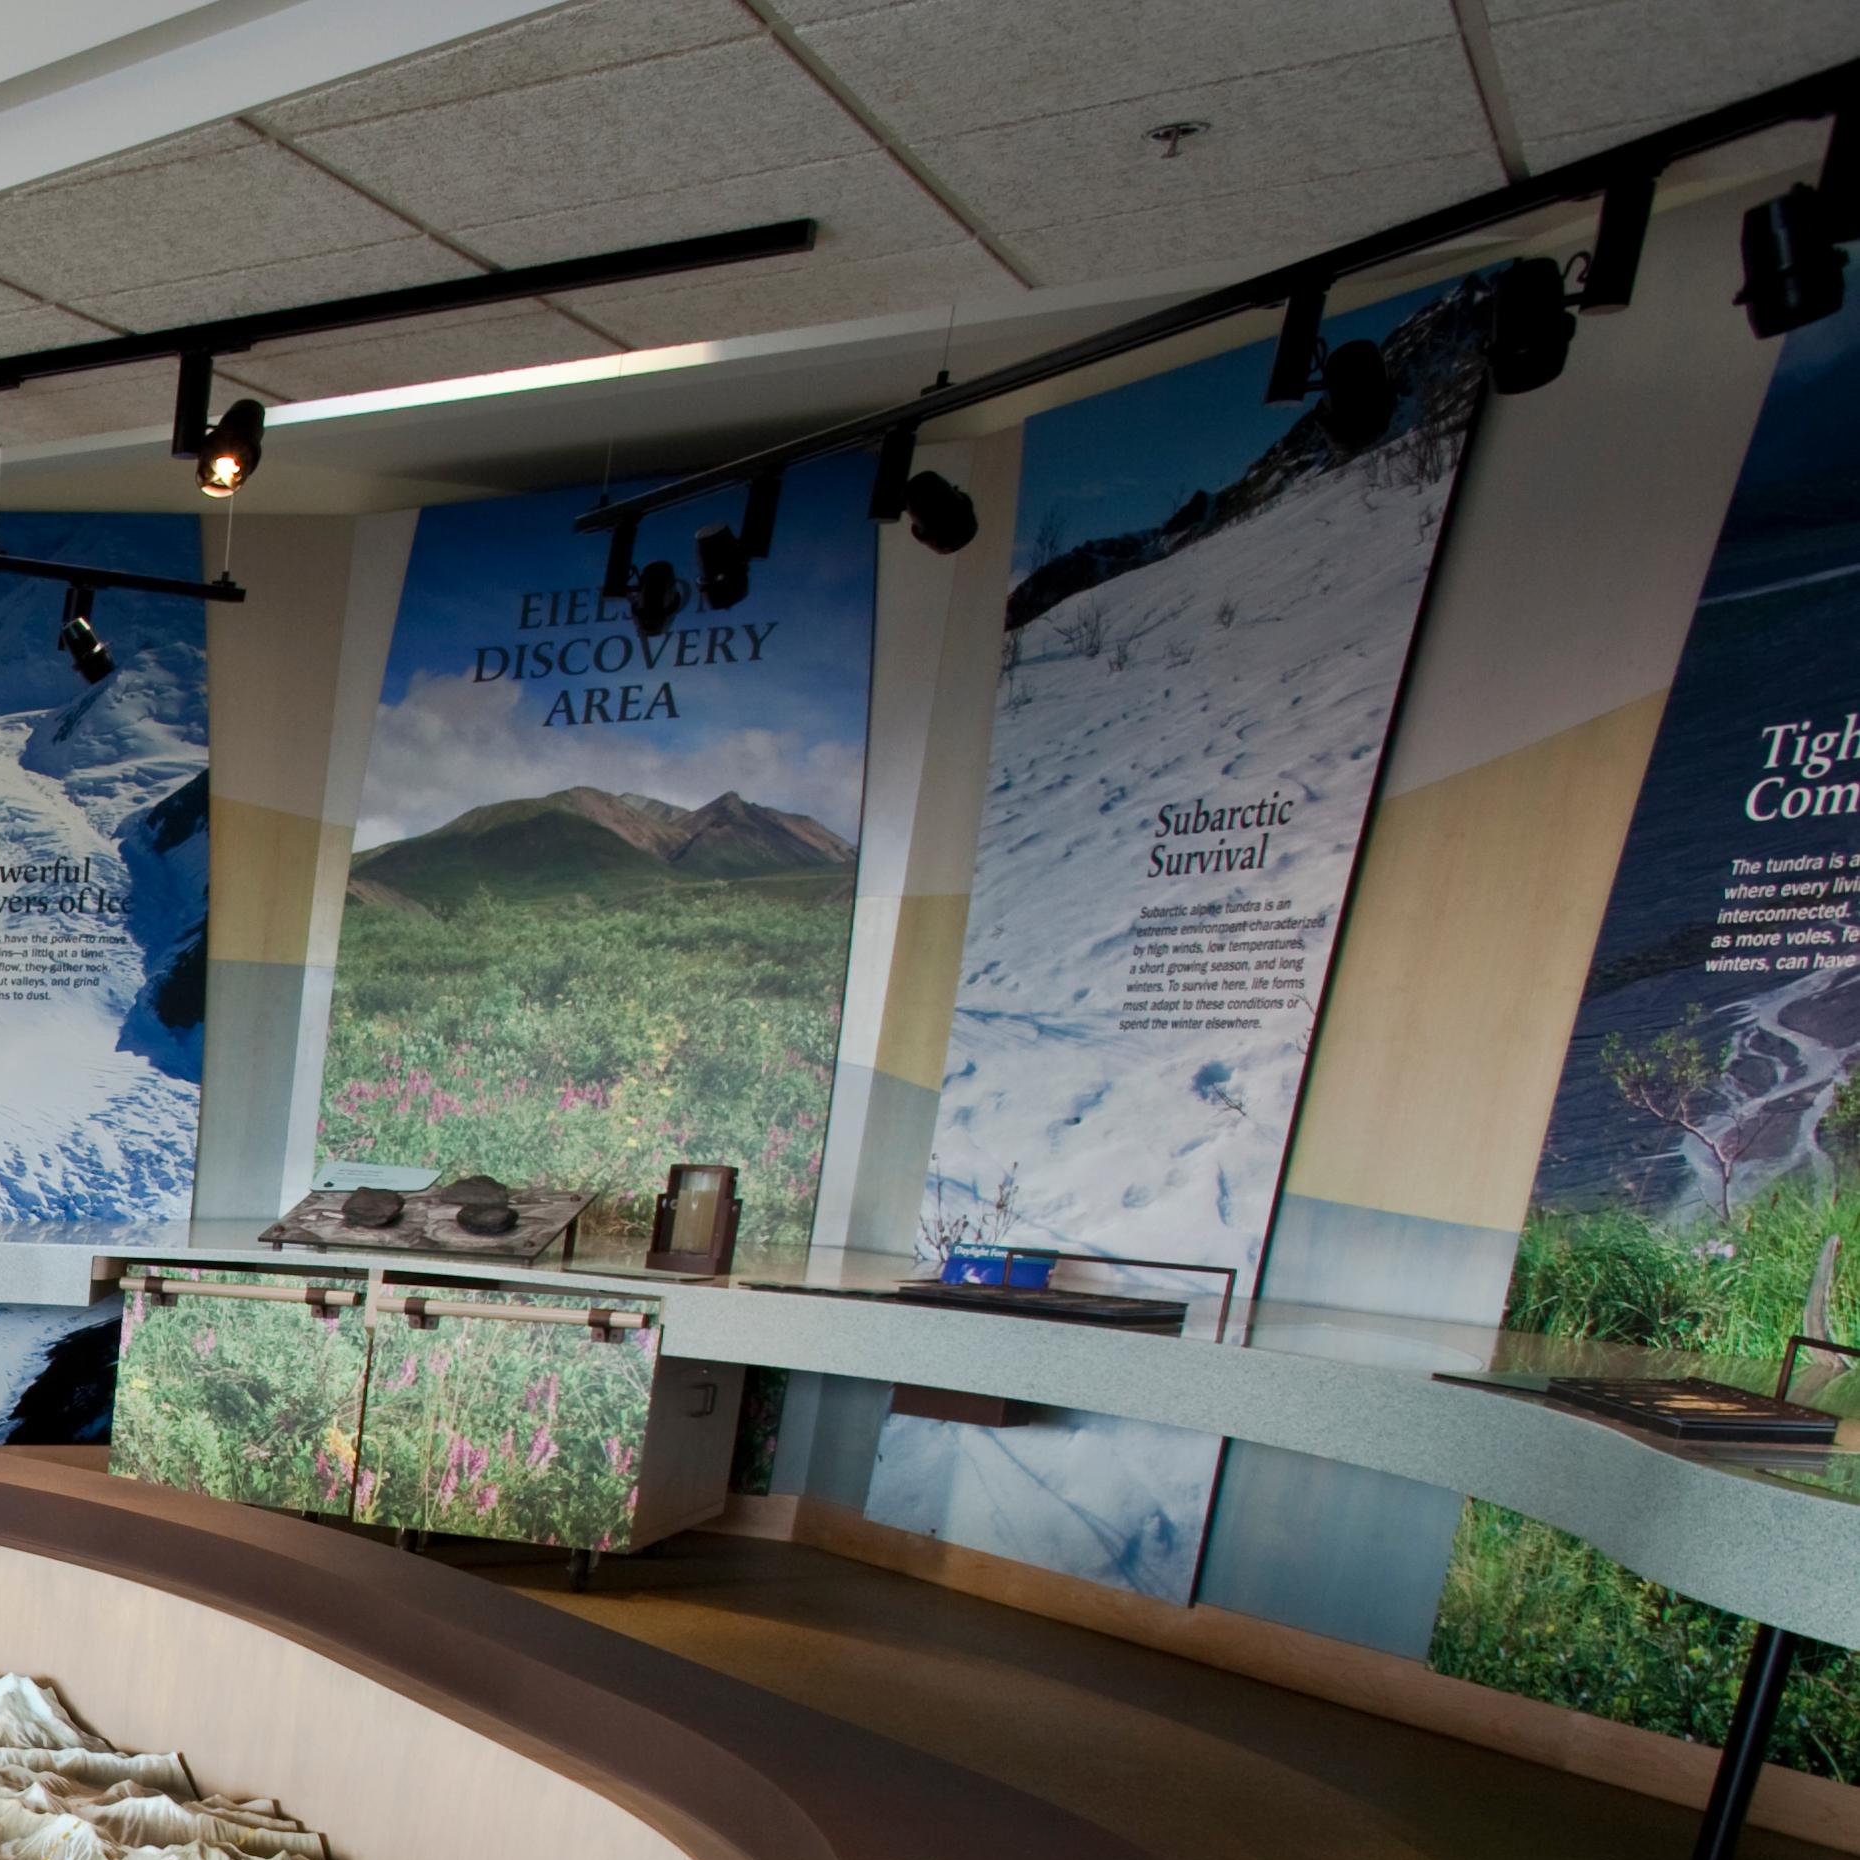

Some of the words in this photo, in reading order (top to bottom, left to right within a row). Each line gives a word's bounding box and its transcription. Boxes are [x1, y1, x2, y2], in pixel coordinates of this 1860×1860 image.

[473, 622, 779, 682] DISCOVERY
[543, 682, 680, 727] AREA
[1155, 791, 1294, 837] Subarctic
[1148, 834, 1270, 878] Survival
[1731, 859, 1761, 875] The
[1766, 855, 1823, 873] tundra
[1829, 852, 1844, 869] is
[59, 887, 93, 913] of
[98, 890, 134, 913] Ice
[1724, 884, 1776, 899] where
[1781, 881, 1829, 898] every
[1140, 905, 1188, 919] Subarctic
[1190, 904, 1222, 918] alpine
[1225, 902, 1261, 914] tundra
[1264, 900, 1273, 912] is
[1277, 899, 1291, 911] an
[1717, 902, 1851, 924] interconnected.
[1137, 925, 1178, 937] extreme
[1181, 921, 1247, 935] environment
[1249, 916, 1325, 932] characterized
[5, 934, 28, 943] have
[32, 934, 48, 943] the
[51, 935, 83, 946] power
[85, 935, 95, 944] to
[99, 935, 127, 944] move
[1133, 945, 1145, 957] by
[1148, 943, 1169, 957] high
[1172, 942, 1204, 955] winds,
[1207, 941, 1225, 953] low
[1229, 938, 1306, 953] temperatures,
[1711, 935, 1732, 948] as
[1735, 932, 1781, 946] more
[1786, 928, 1835, 945] voles,
[32, 948, 54, 958] little
[57, 949, 68, 957] at
[1705, 956, 1769, 972] winters,
[1776, 956, 1807, 970] can
[1813, 952, 1856, 968] have
[0, 962, 22, 973] flow,
[25, 962, 46, 975] they
[50, 963, 83, 974] gather
[11, 976, 48, 988] valleys,
[51, 976, 70, 986] and
[73, 976, 100, 988] grind
[13, 992, 23, 1000] to
[26, 991, 51, 1000] dust.
